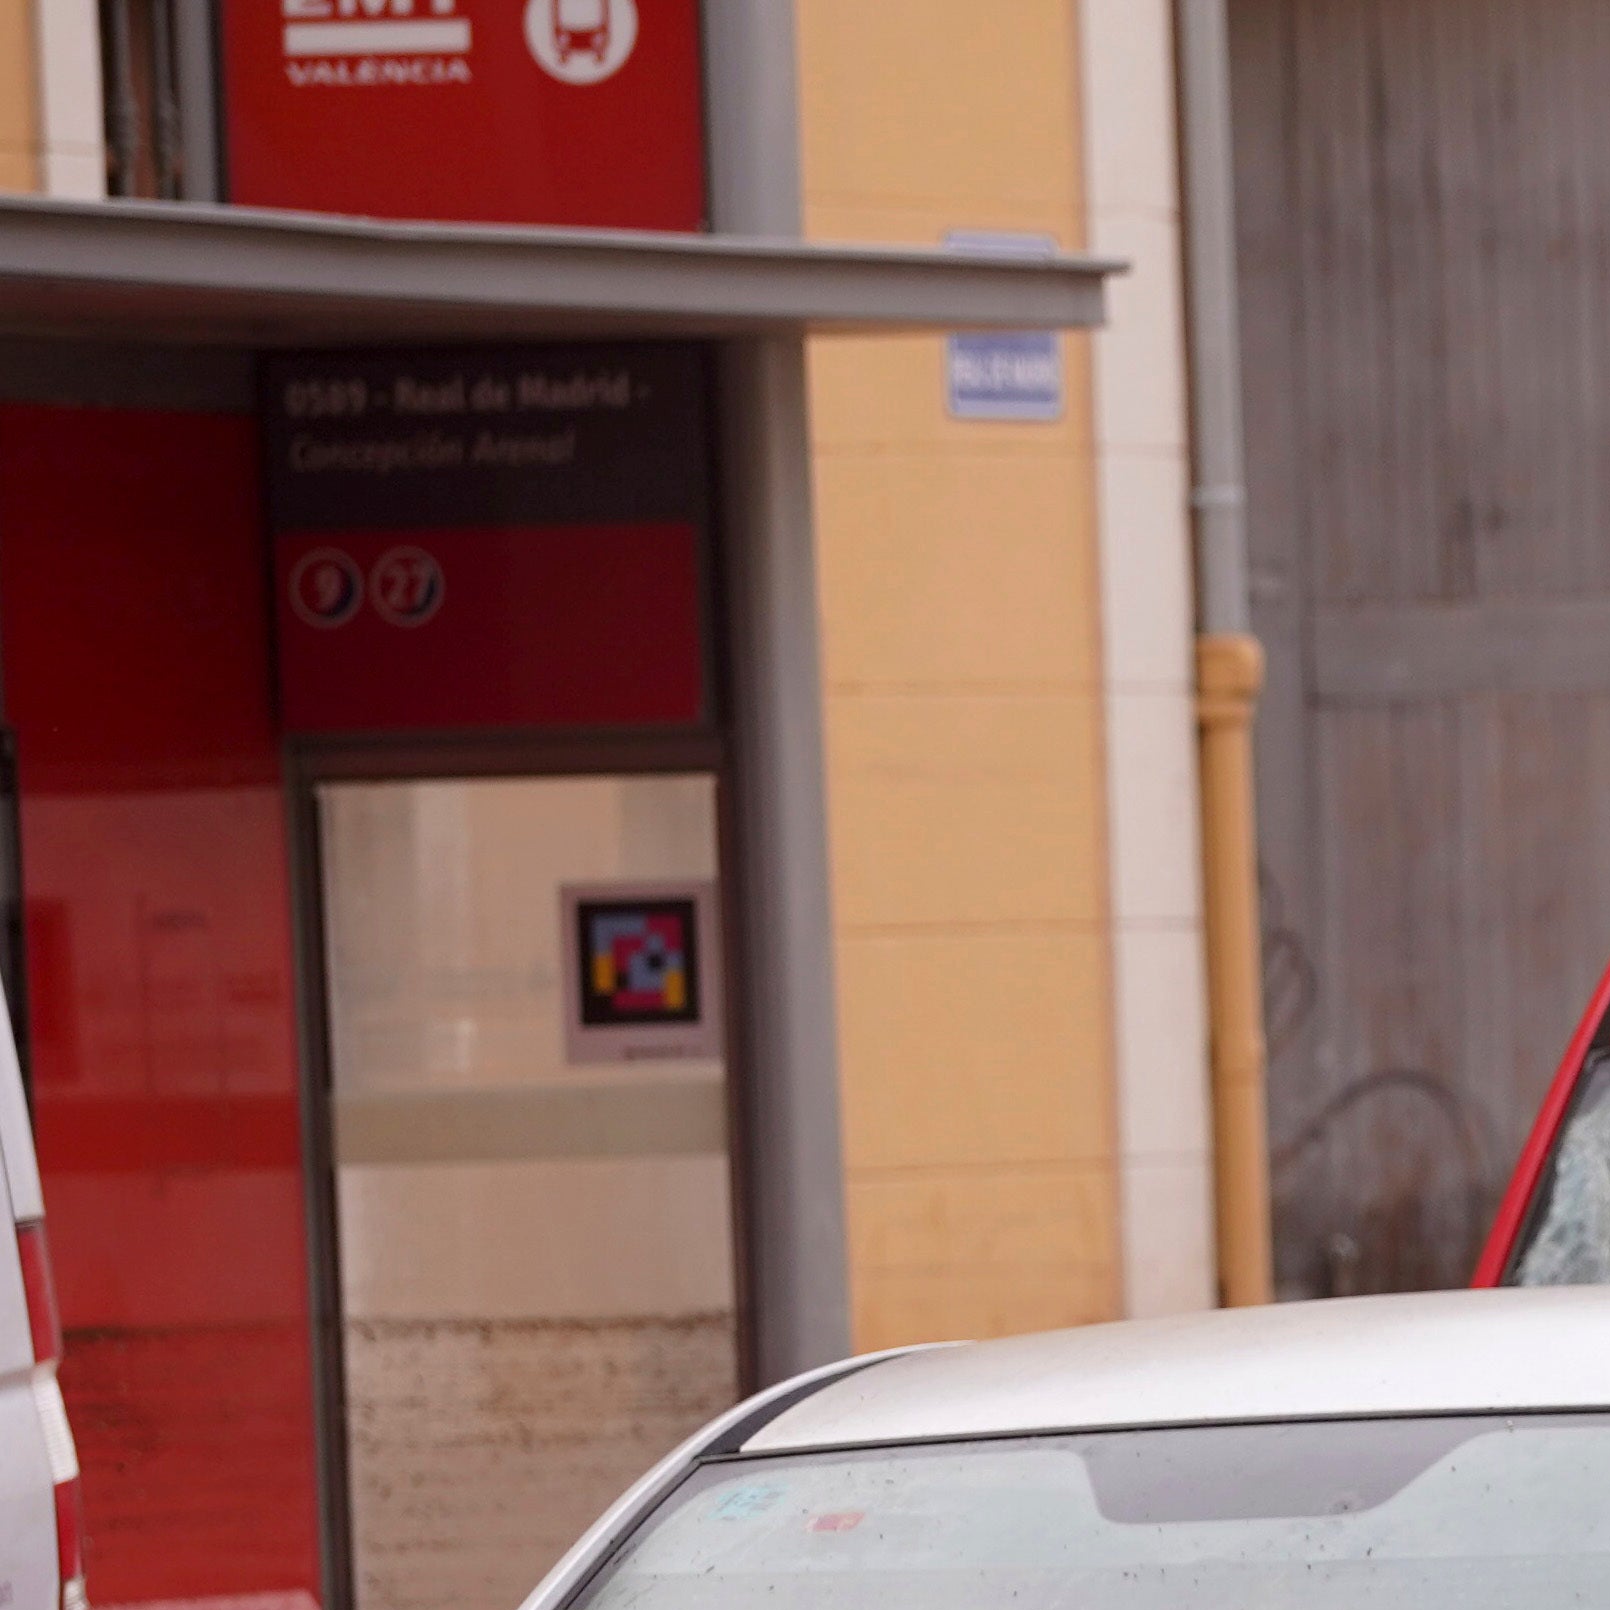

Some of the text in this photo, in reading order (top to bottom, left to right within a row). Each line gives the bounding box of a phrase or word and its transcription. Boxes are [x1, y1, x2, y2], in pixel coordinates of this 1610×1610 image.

[393, 373, 465, 416] Real
[470, 373, 511, 412] de
[516, 369, 631, 412] Madrid
[472, 425, 576, 467] Arenal
[315, 560, 434, 610] 9 27
